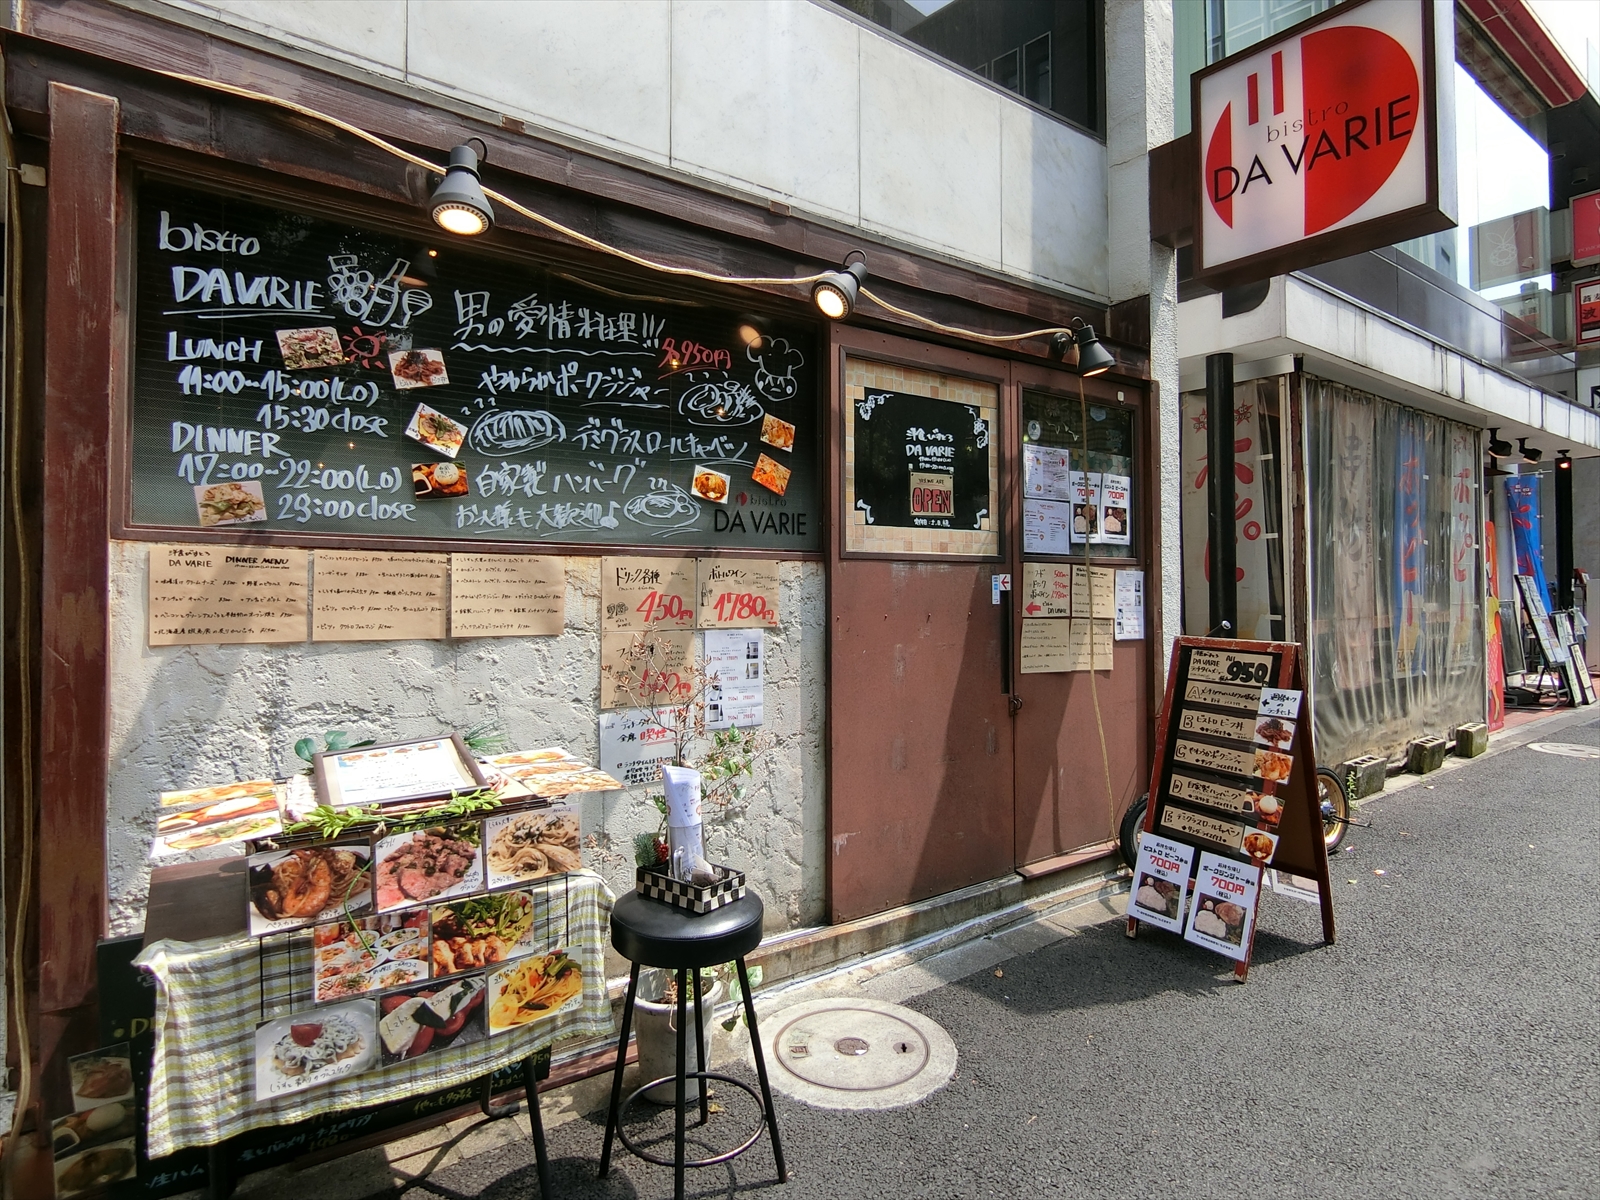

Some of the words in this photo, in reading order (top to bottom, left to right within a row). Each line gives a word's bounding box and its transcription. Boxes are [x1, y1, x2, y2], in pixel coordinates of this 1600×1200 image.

[1266, 101, 1349, 143] bistro
[1214, 154, 1273, 203] DA
[1281, 94, 1412, 175] VARIE
[159, 211, 260, 255] bistro
[168, 331, 263, 363] LUNCH
[172, 421, 292, 458] DINNER
[905, 444, 922, 456] DA
[925, 446, 956, 458] VARIE
[750, 494, 787, 507] bistro
[912, 487, 952, 513] OPEN
[714, 508, 747, 533] DA
[750, 510, 807, 536] VARIE
[169, 559, 182, 567] DA
[185, 559, 213, 568] VARIE
[225, 555, 259, 565] DINNER
[261, 556, 289, 566] MENU
[616, 567, 662, 587] ドリンク各種
[708, 565, 747, 581] ボトルワイン
[1202, 659, 1220, 668] VARIE
[1143, 844, 1163, 856] ビストロ
[1149, 854, 1181, 874] 700円
[1210, 875, 1246, 896] 700円
